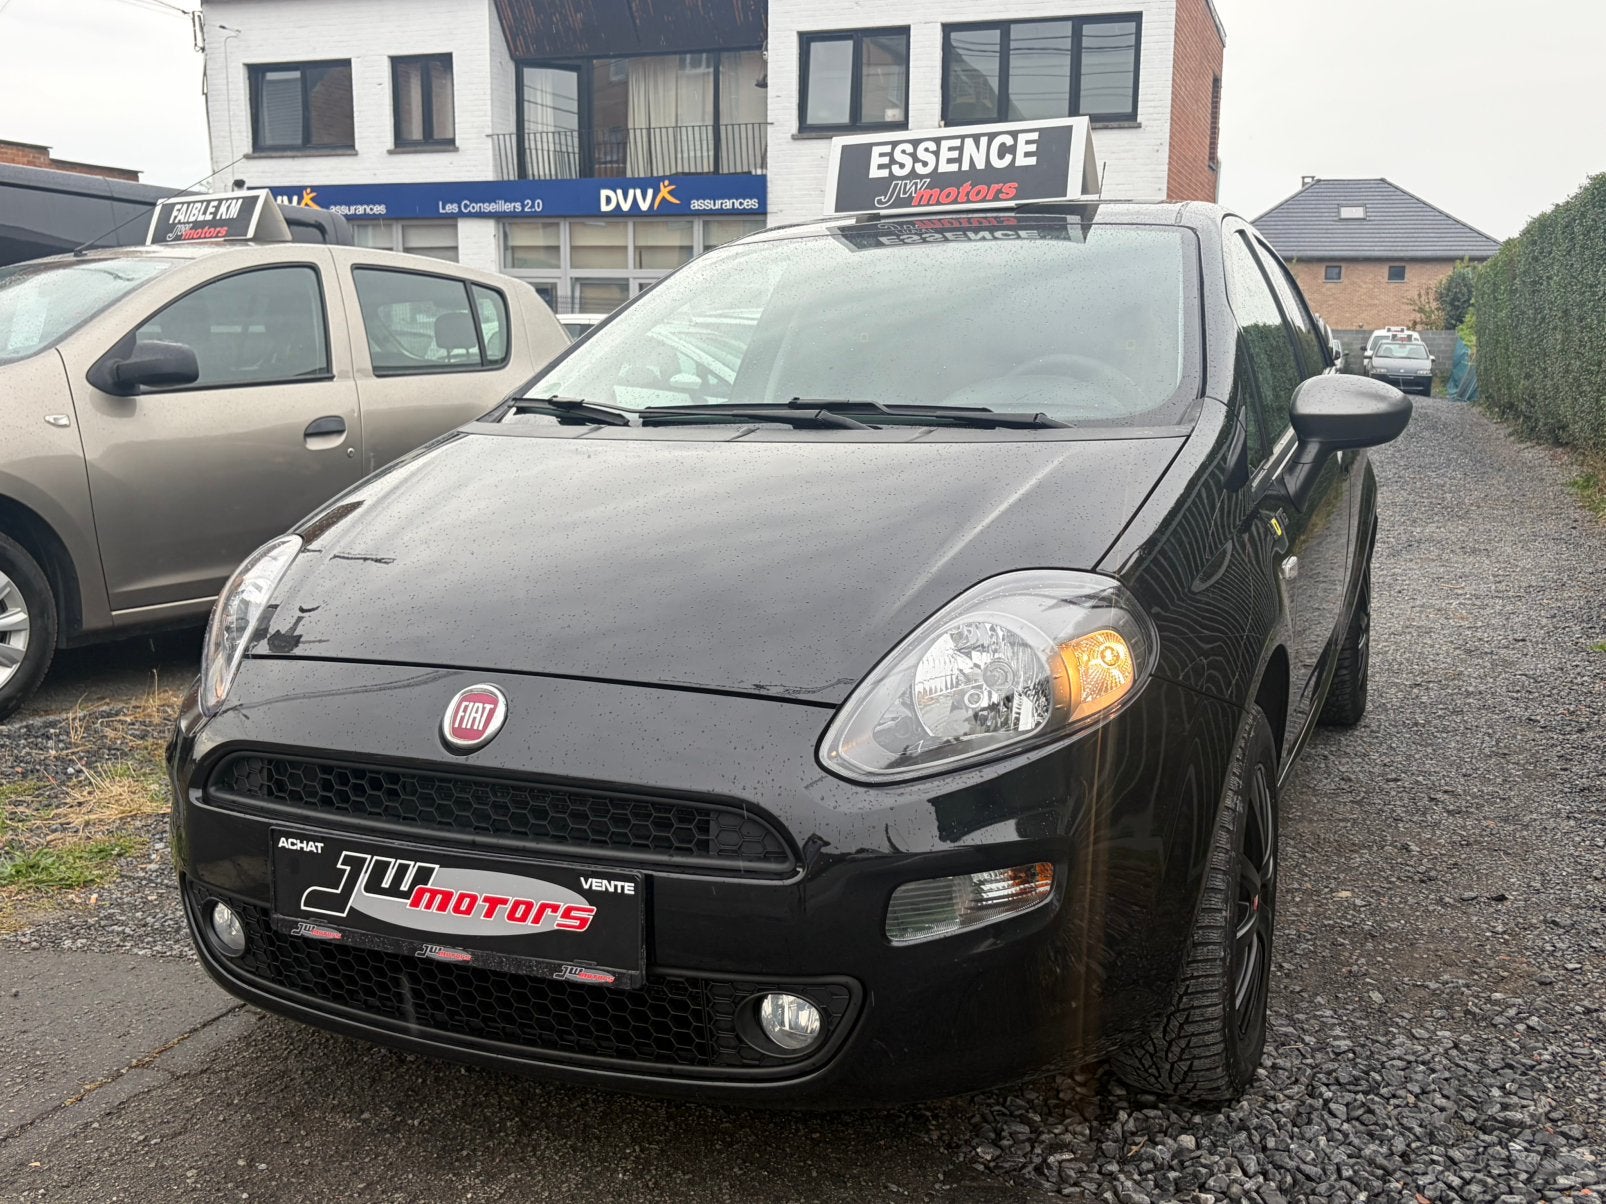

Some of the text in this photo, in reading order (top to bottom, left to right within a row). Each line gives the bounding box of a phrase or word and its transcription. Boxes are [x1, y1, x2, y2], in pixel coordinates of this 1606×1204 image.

[869, 131, 1039, 179] ESSENCE
[600, 188, 759, 212] DVV assurances
[874, 178, 1019, 208] JW motors
[168, 198, 243, 224] FAIBLE KM
[329, 204, 386, 215] assurances
[438, 199, 543, 213] Les Conseillers 2.0
[181, 226, 228, 239] motors
[453, 701, 494, 731] FIAT
[278, 837, 324, 854] ACHAT
[300, 850, 440, 917] JW
[580, 876, 635, 895] VENTE
